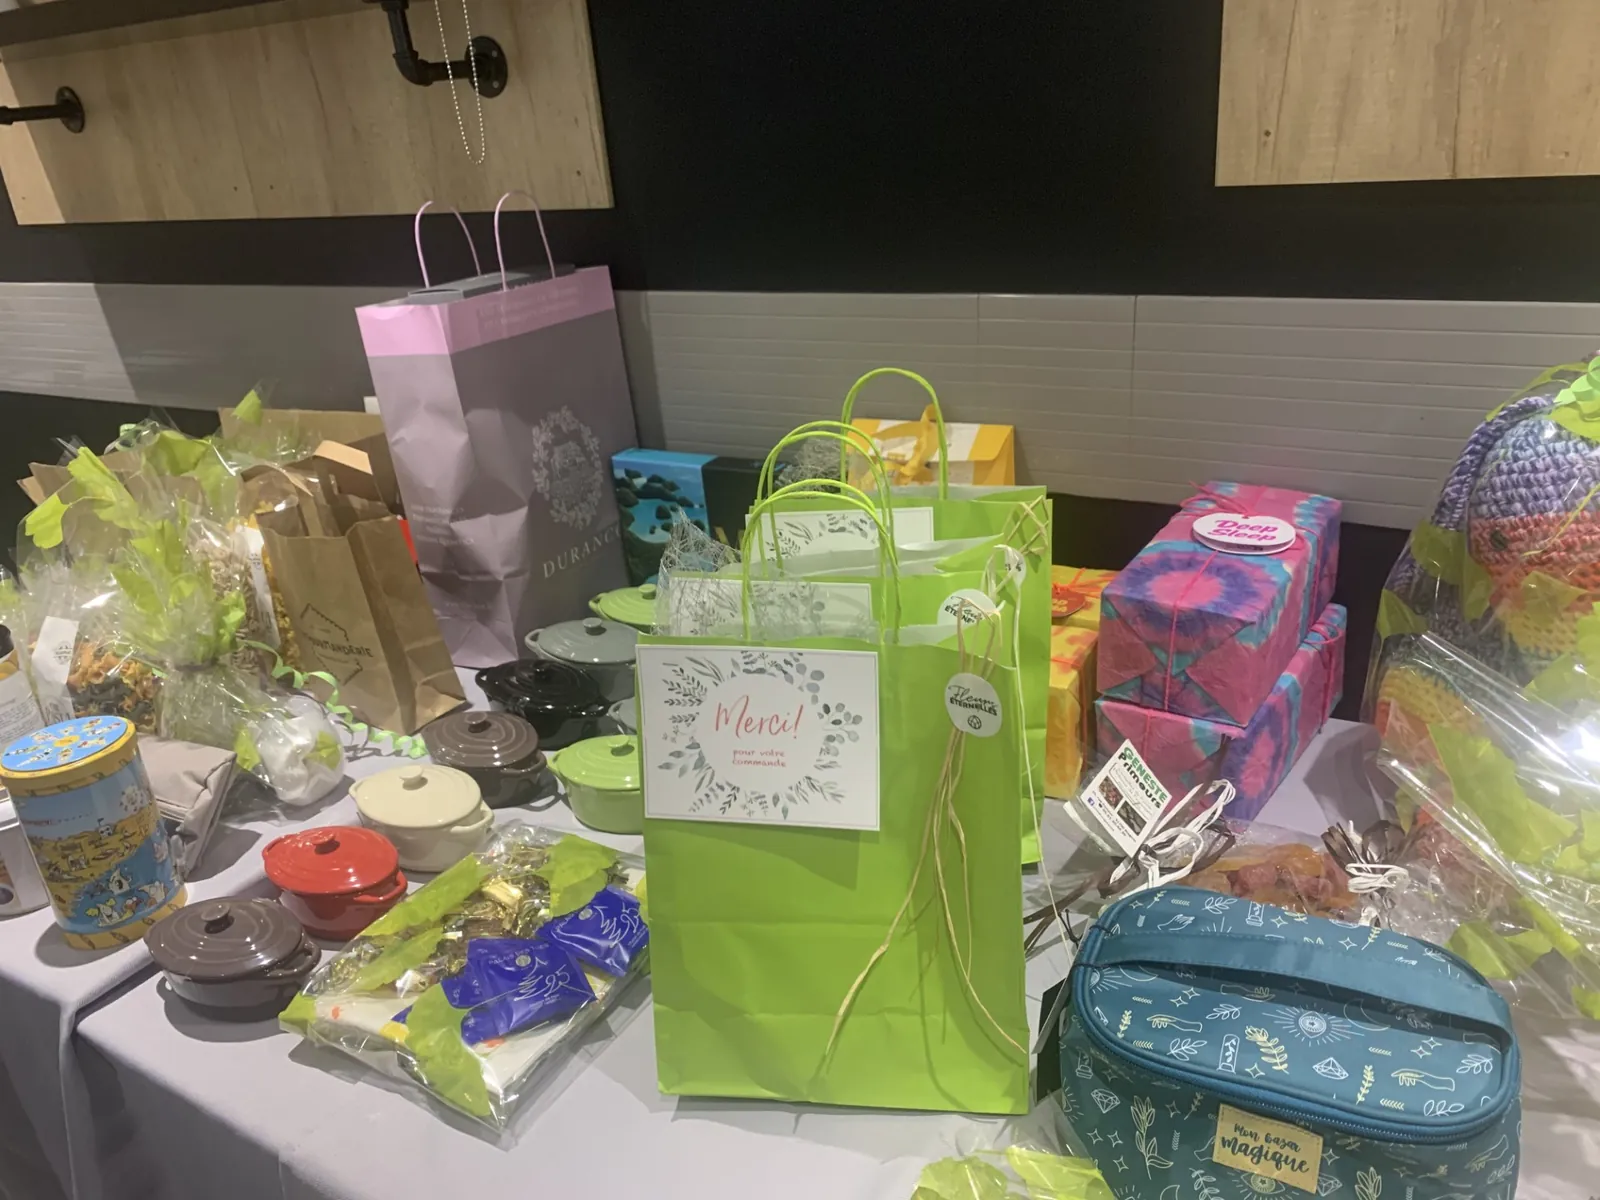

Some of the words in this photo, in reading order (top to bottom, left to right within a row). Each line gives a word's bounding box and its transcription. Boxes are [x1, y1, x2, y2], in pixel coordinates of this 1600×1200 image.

[1207, 528, 1277, 542] Sleep
[1214, 519, 1279, 534] Deep
[714, 694, 804, 740] Merci!
[731, 758, 787, 768] commande
[732, 749, 756, 760] pour
[759, 748, 786, 758] votre
[1117, 751, 1161, 810] Primeurs
[1122, 746, 1168, 804] GENESTE
[1234, 1123, 1260, 1142] Mon
[1264, 1132, 1301, 1153] bazar
[1221, 1136, 1310, 1174] magique
